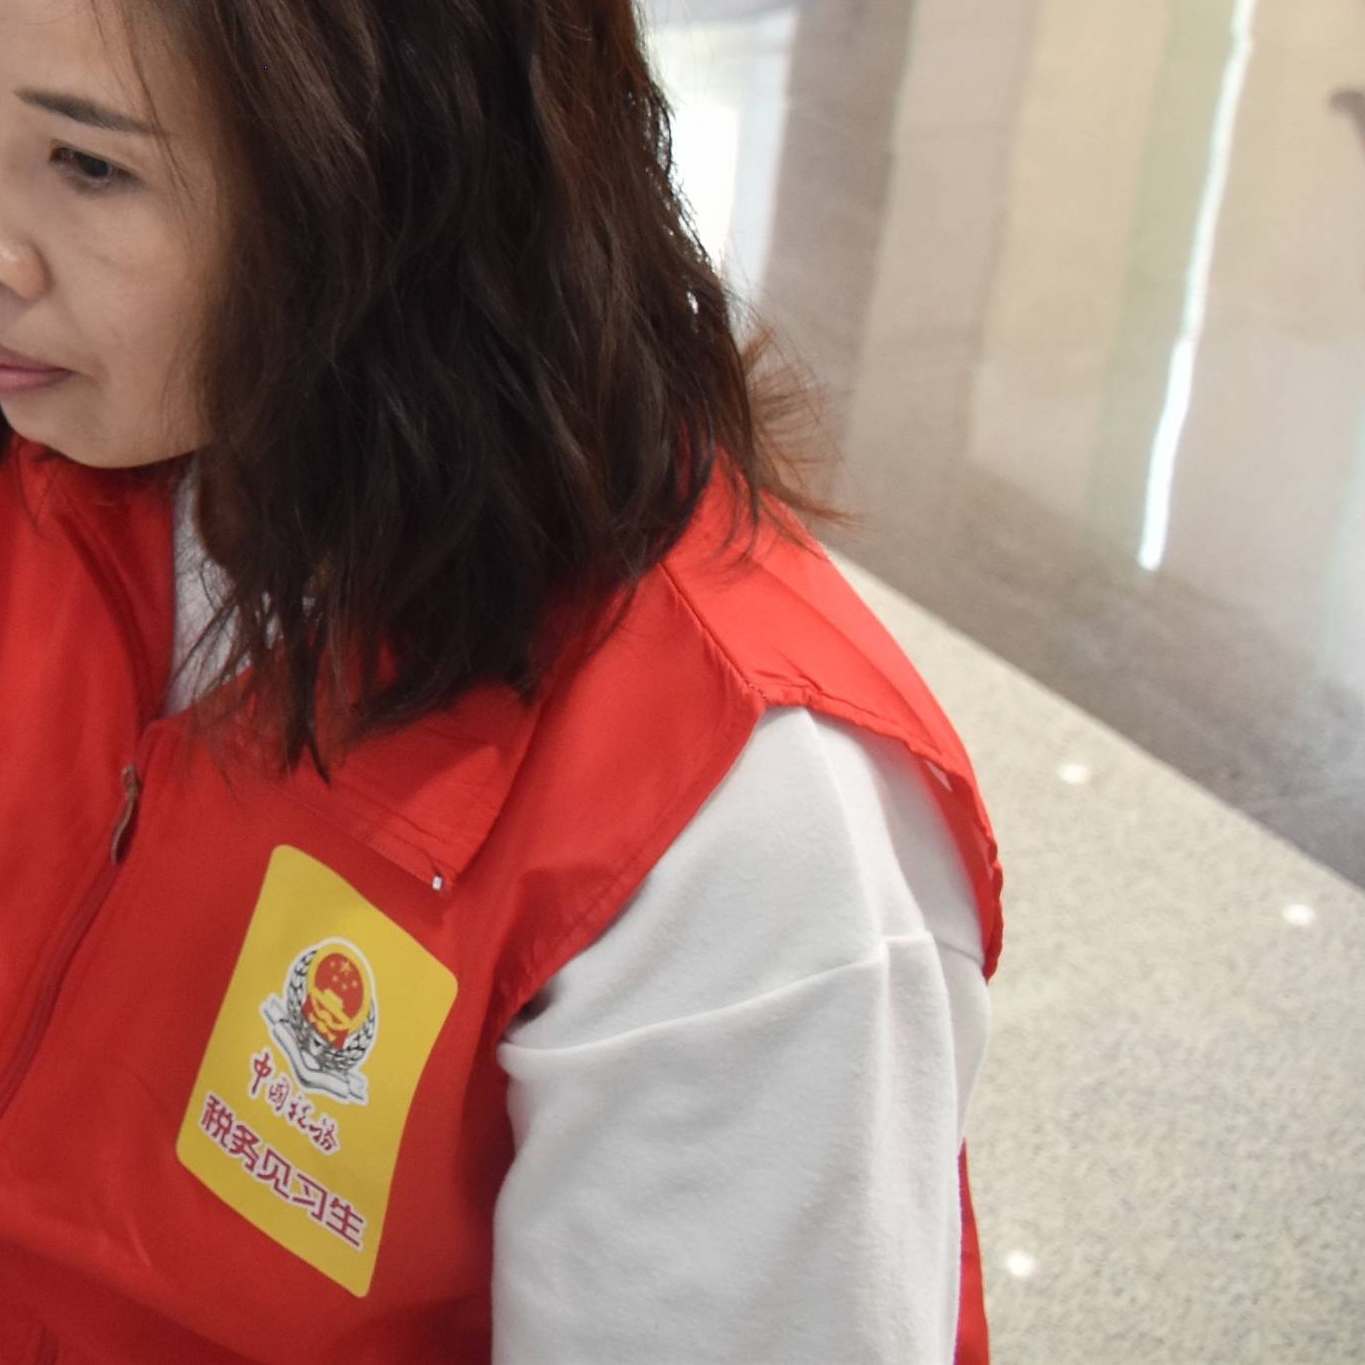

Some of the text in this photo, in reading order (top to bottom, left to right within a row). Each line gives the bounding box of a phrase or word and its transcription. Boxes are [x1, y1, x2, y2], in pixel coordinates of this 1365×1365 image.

[200, 1094, 364, 1248] 税务见习生
